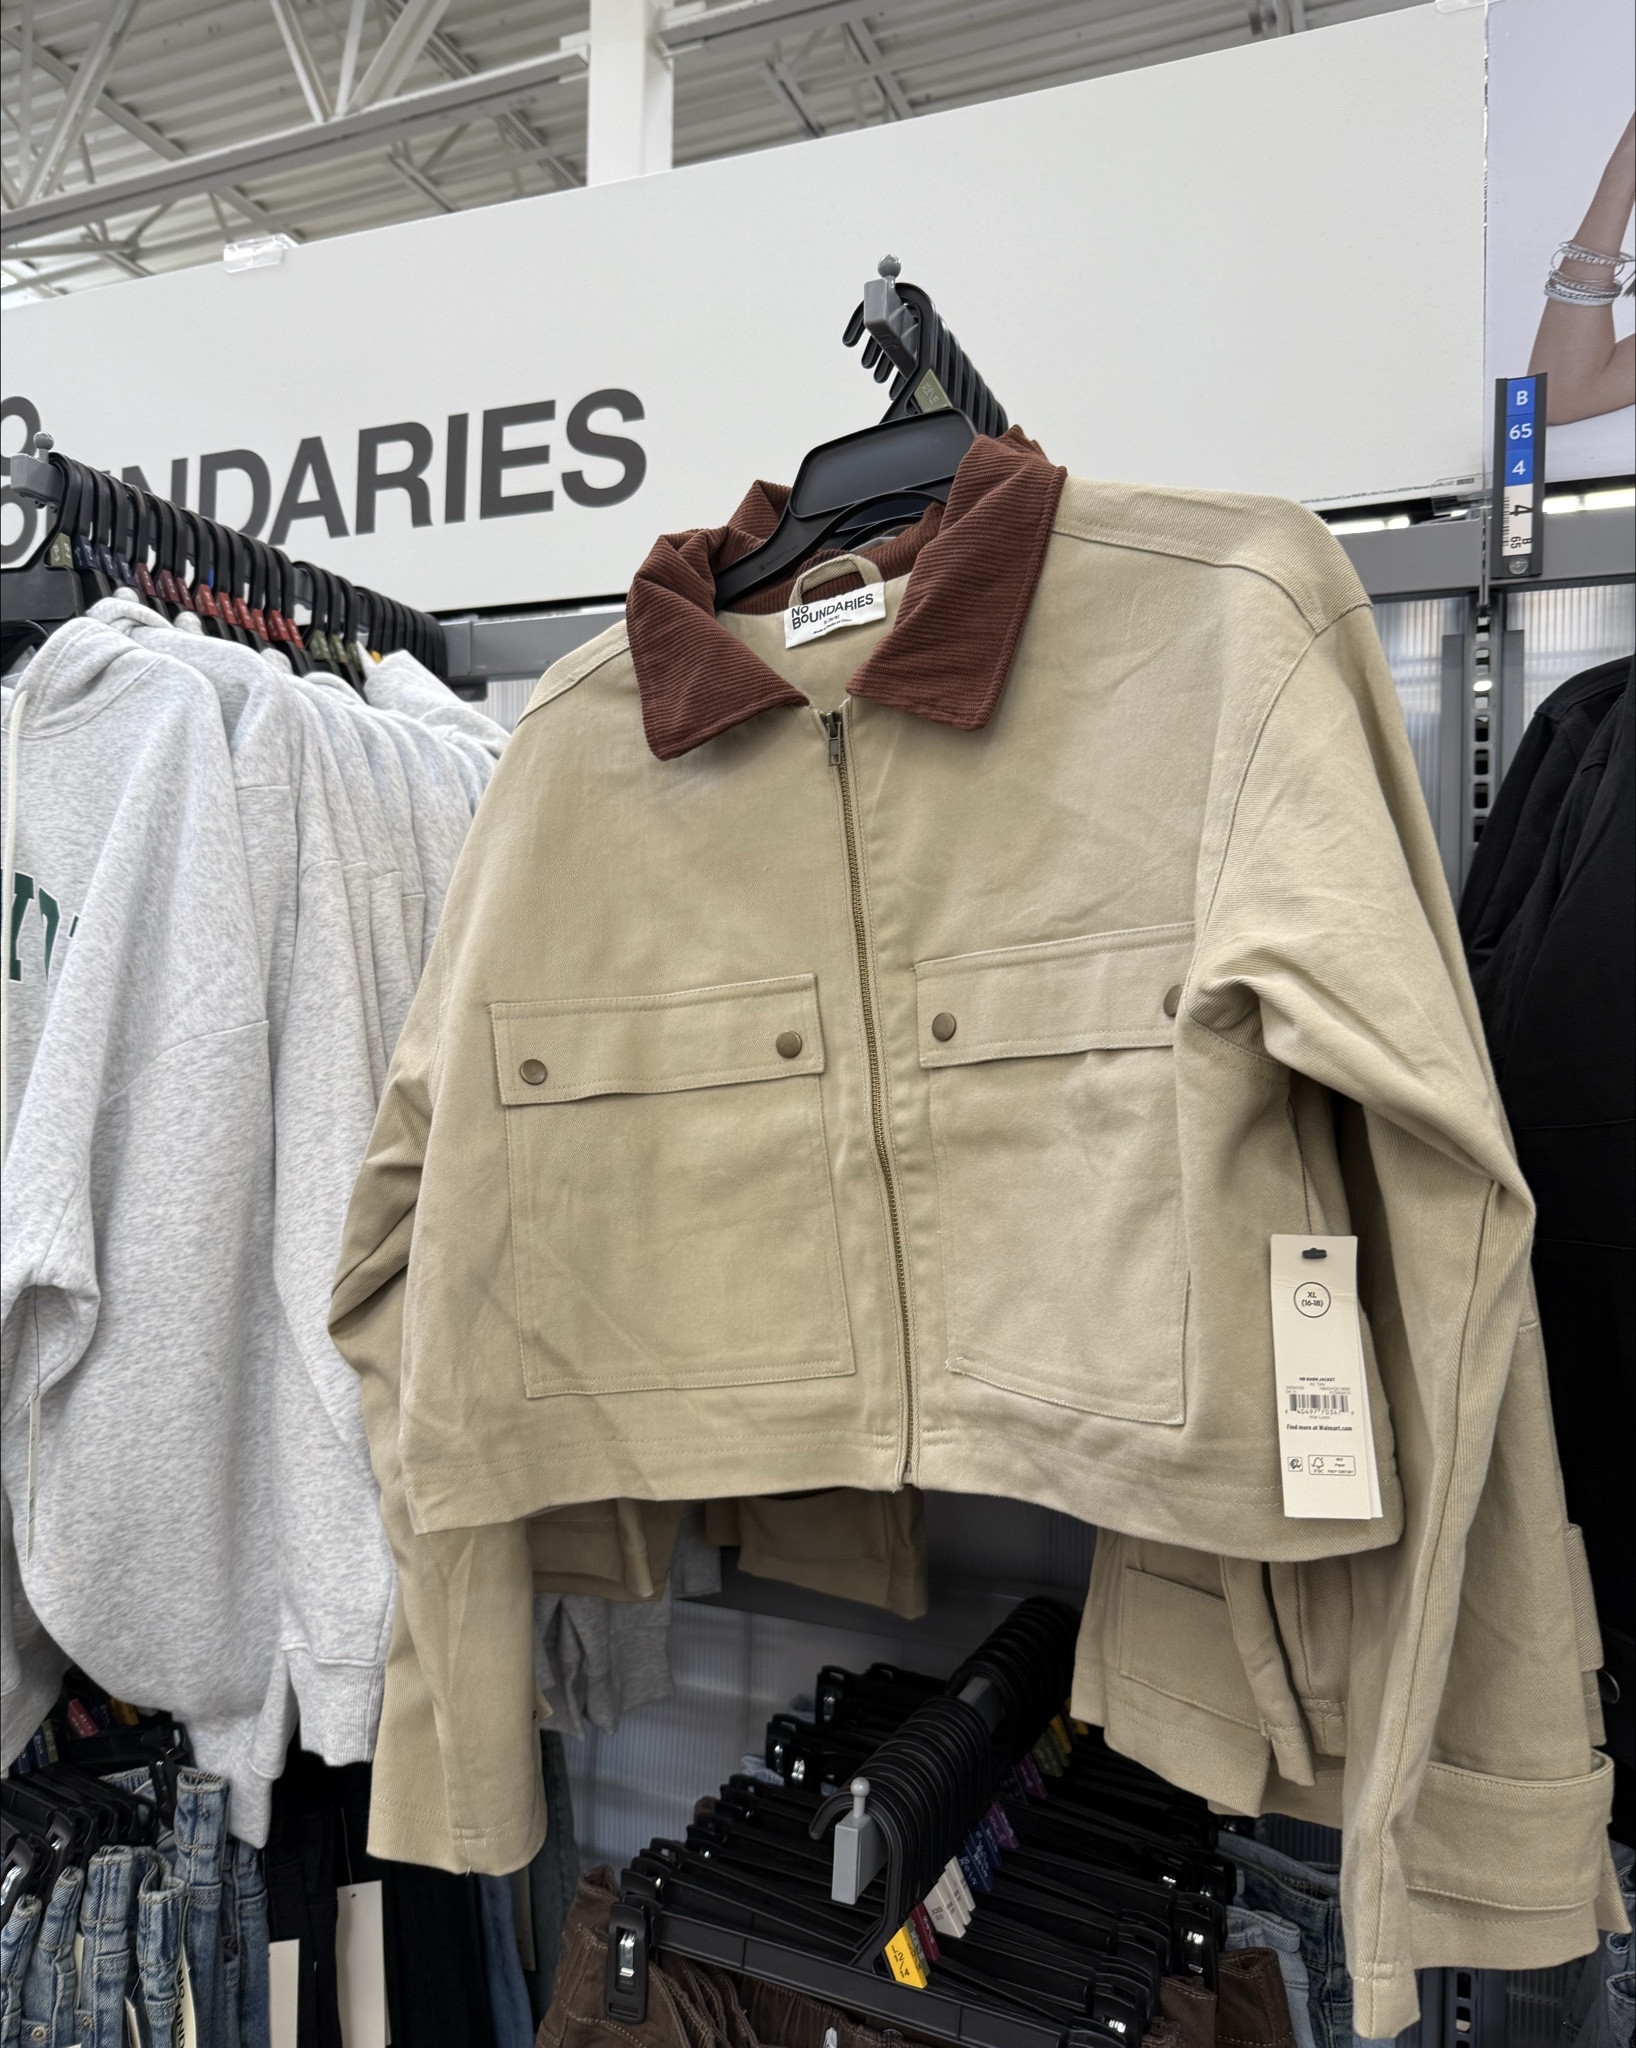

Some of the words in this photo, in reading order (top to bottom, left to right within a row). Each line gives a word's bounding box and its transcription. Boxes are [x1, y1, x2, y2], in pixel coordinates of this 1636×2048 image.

[1515, 390, 1529, 406] B
[1508, 422, 1533, 440] 65
[1511, 459, 1526, 476] 4
[1509, 504, 1533, 517] 4
[1510, 536, 1522, 549] 65
[791, 605, 809, 619] NO
[792, 593, 874, 630] BOUNDARIES
[1307, 1291, 1318, 1299] XL
[1301, 1299, 1324, 1307] (16-18)
